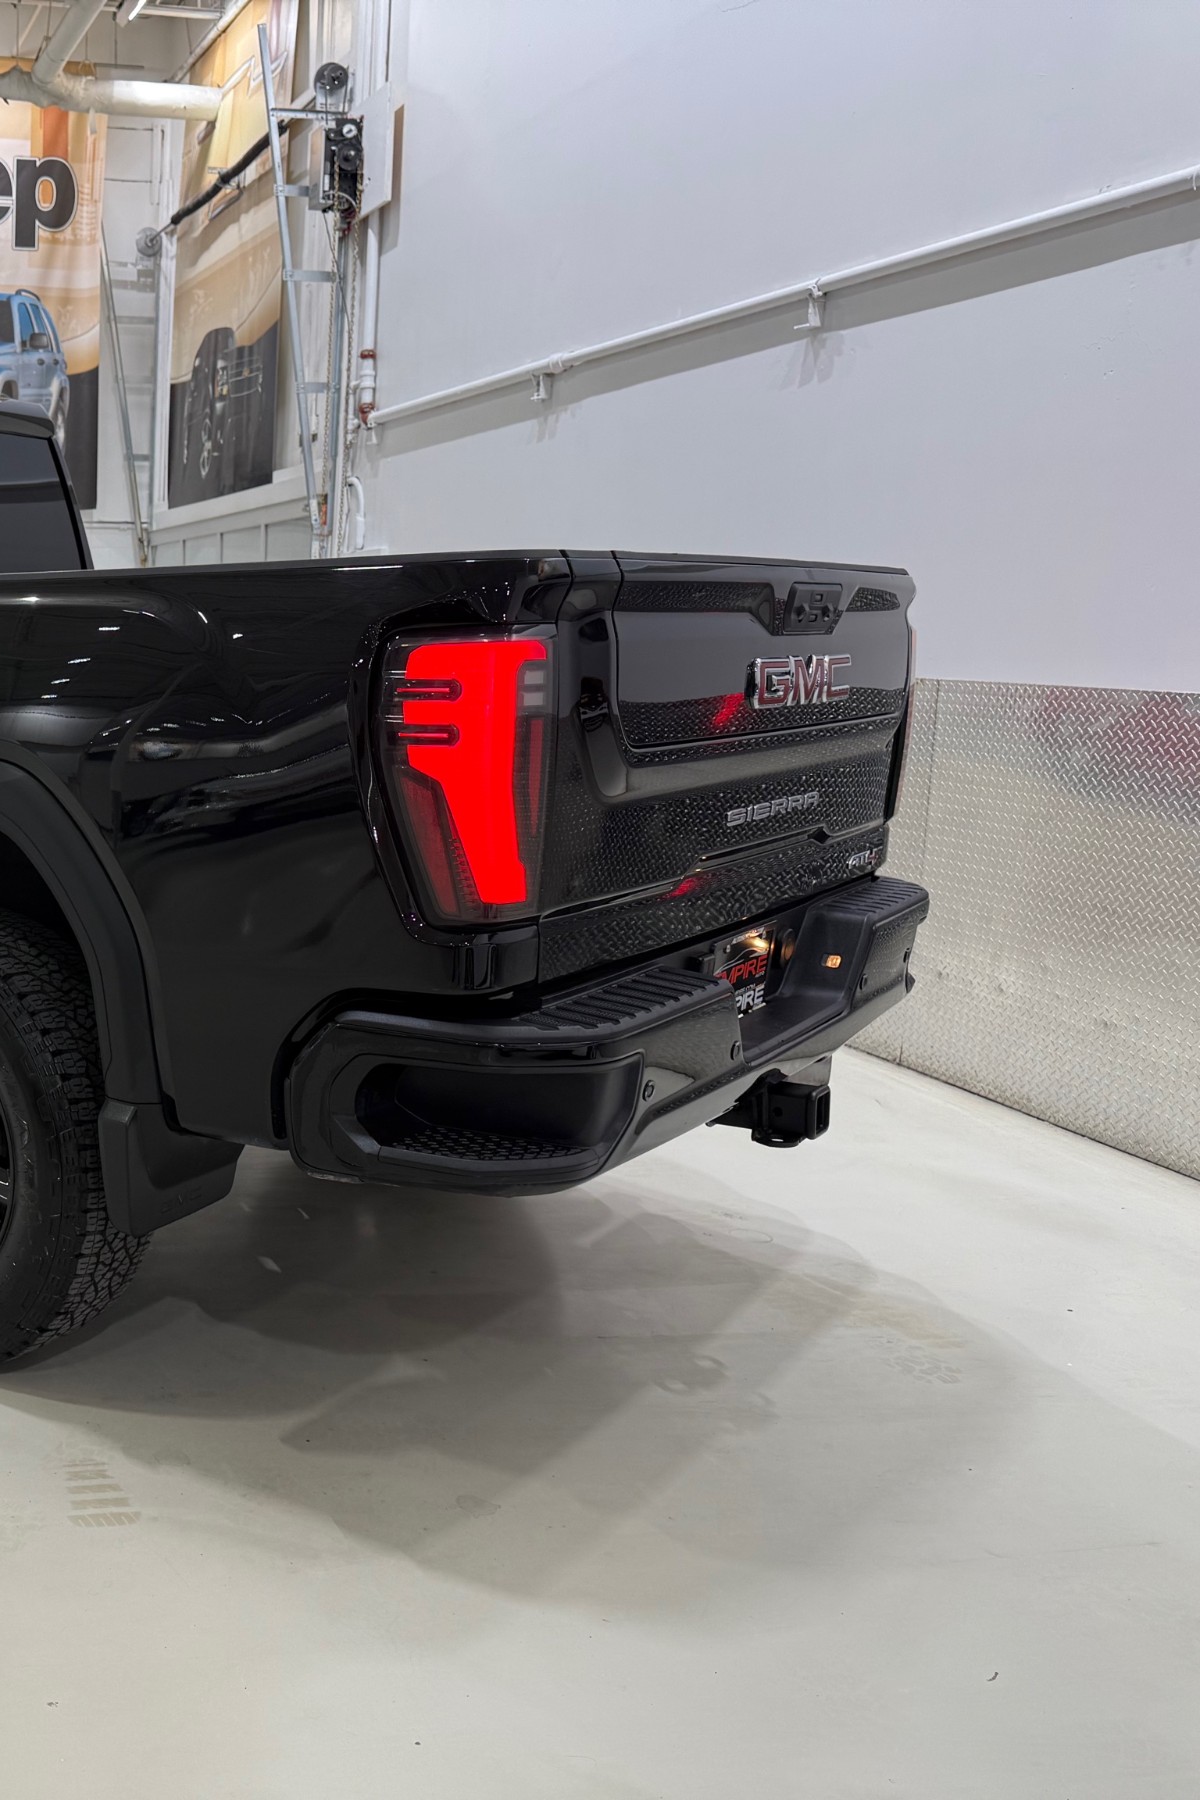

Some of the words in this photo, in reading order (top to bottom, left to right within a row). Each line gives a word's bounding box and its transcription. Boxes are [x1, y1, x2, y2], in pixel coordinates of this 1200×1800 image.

[750, 653, 852, 709] GMC
[726, 791, 820, 827] SIERRA
[849, 847, 879, 870] AT4
[714, 953, 768, 985] MPIRE
